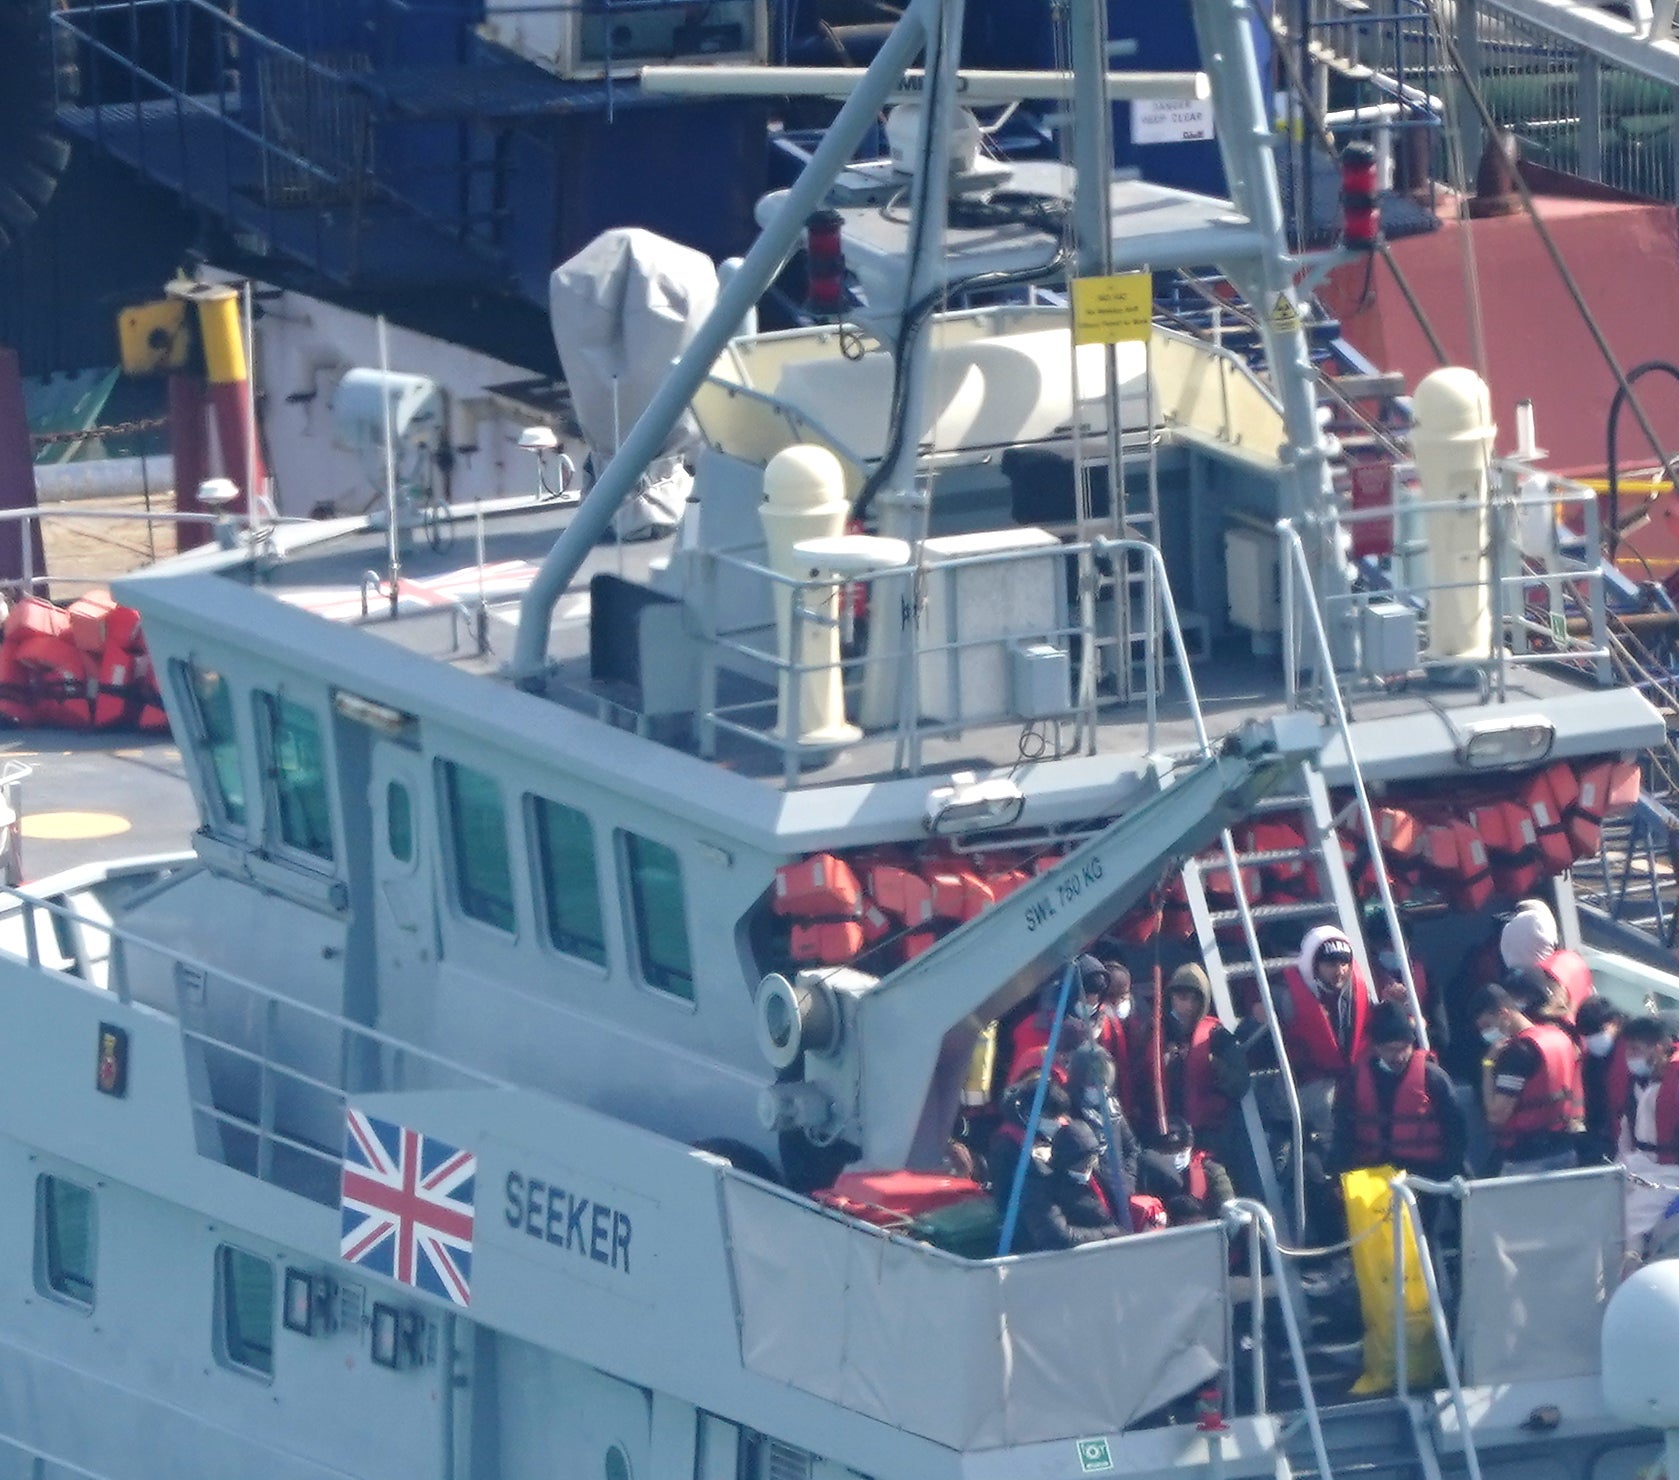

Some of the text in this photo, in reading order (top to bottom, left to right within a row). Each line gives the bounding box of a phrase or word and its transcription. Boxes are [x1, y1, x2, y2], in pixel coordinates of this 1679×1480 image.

[1057, 874, 1081, 907] 750
[1082, 856, 1103, 887] KG
[504, 1170, 633, 1275] SEEKER
